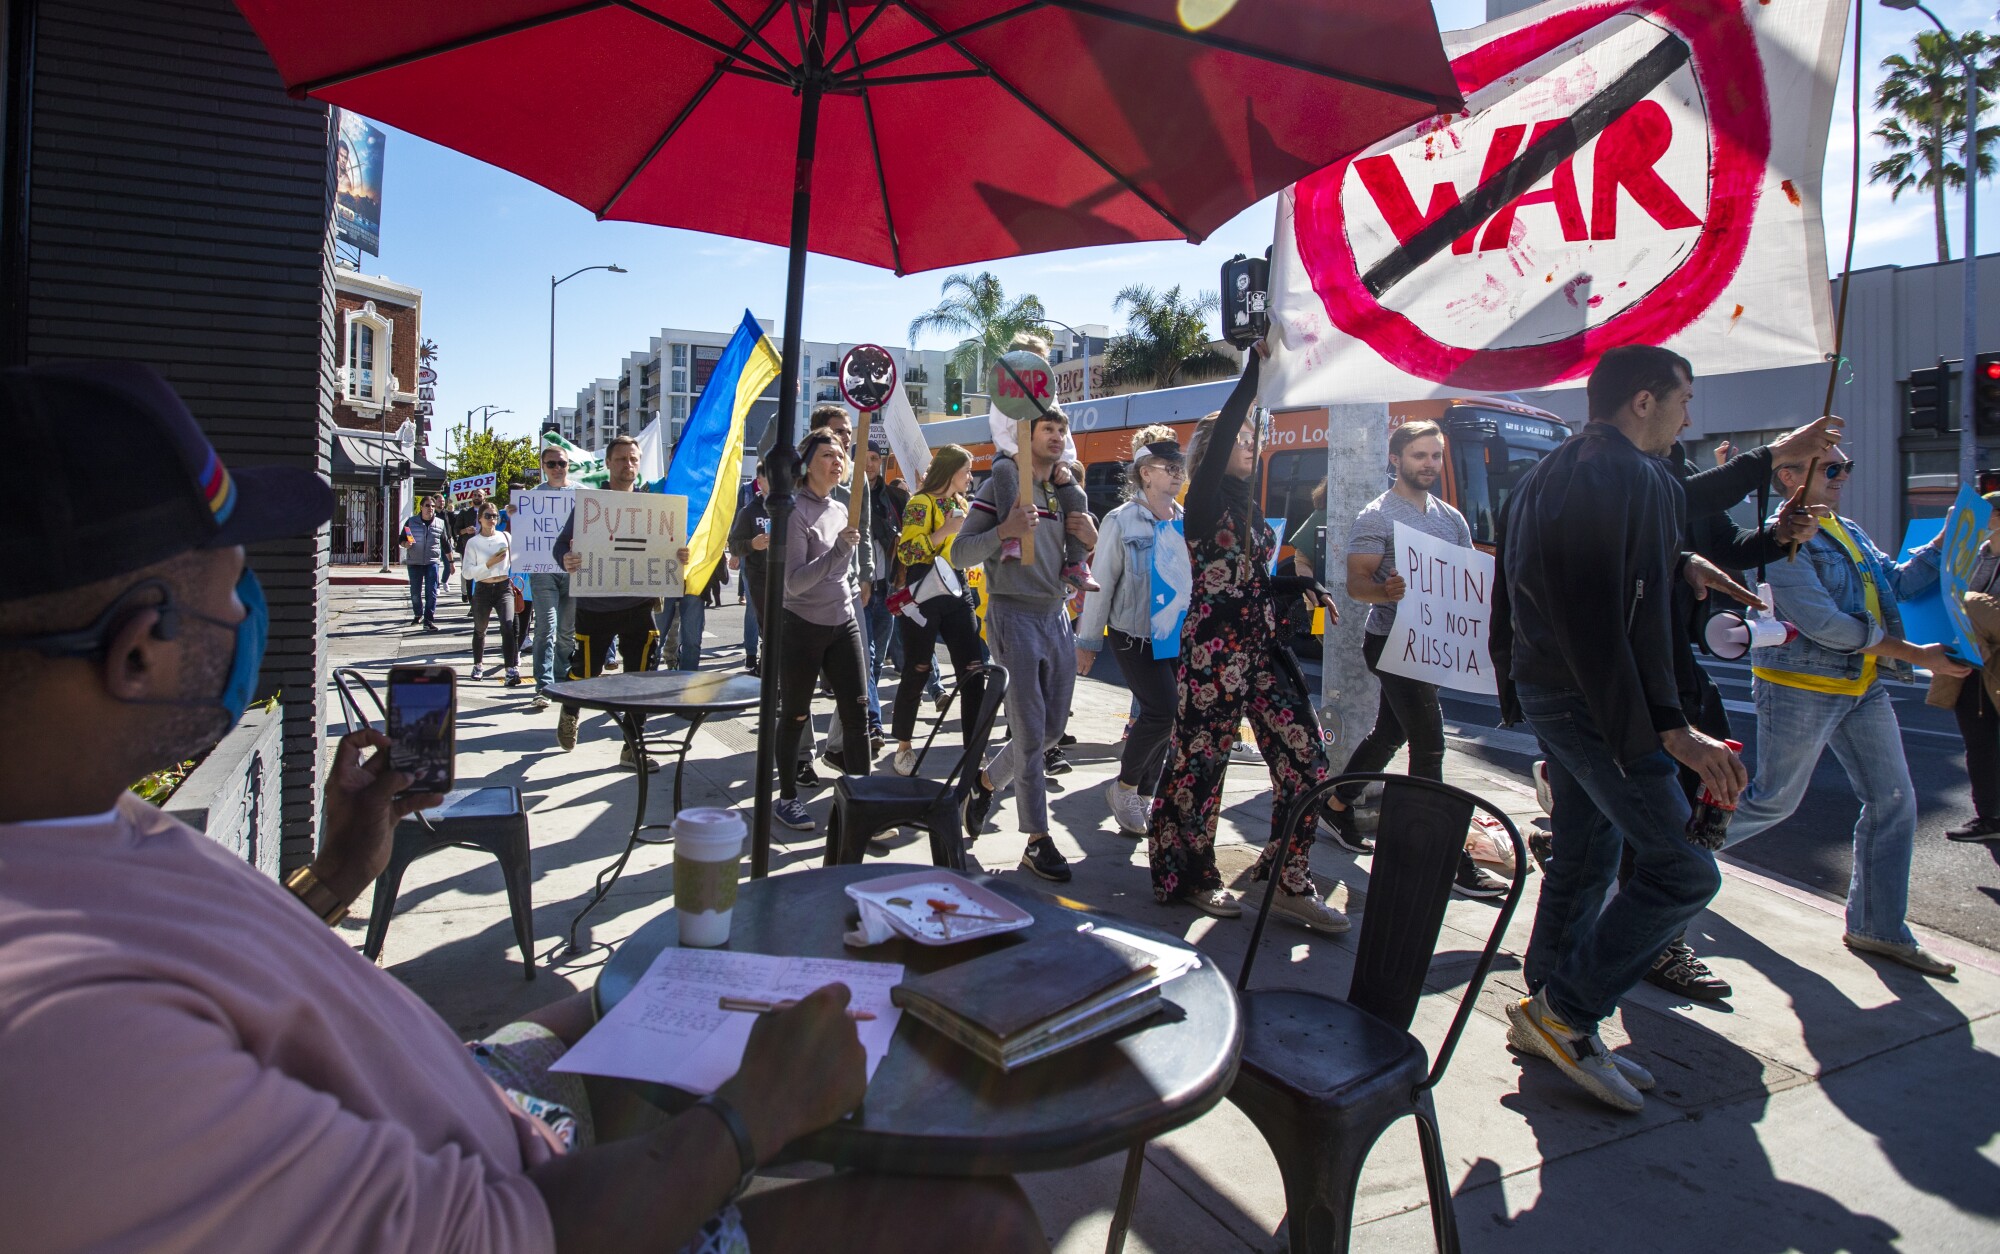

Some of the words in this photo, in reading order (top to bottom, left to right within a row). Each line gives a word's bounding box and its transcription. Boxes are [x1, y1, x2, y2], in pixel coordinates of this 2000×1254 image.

[1352, 99, 1705, 256] WAR
[994, 367, 1050, 399] WAR
[453, 475, 495, 492] STOP
[583, 497, 675, 537] PUTIN
[525, 536, 558, 551] HIT
[533, 563, 554, 573] STOP
[576, 552, 679, 587] HITLER
[1408, 546, 1483, 604] PUTIN
[1420, 601, 1432, 626] IS
[1446, 611, 1482, 638] NOT
[1403, 628, 1480, 676] RUSSIA
